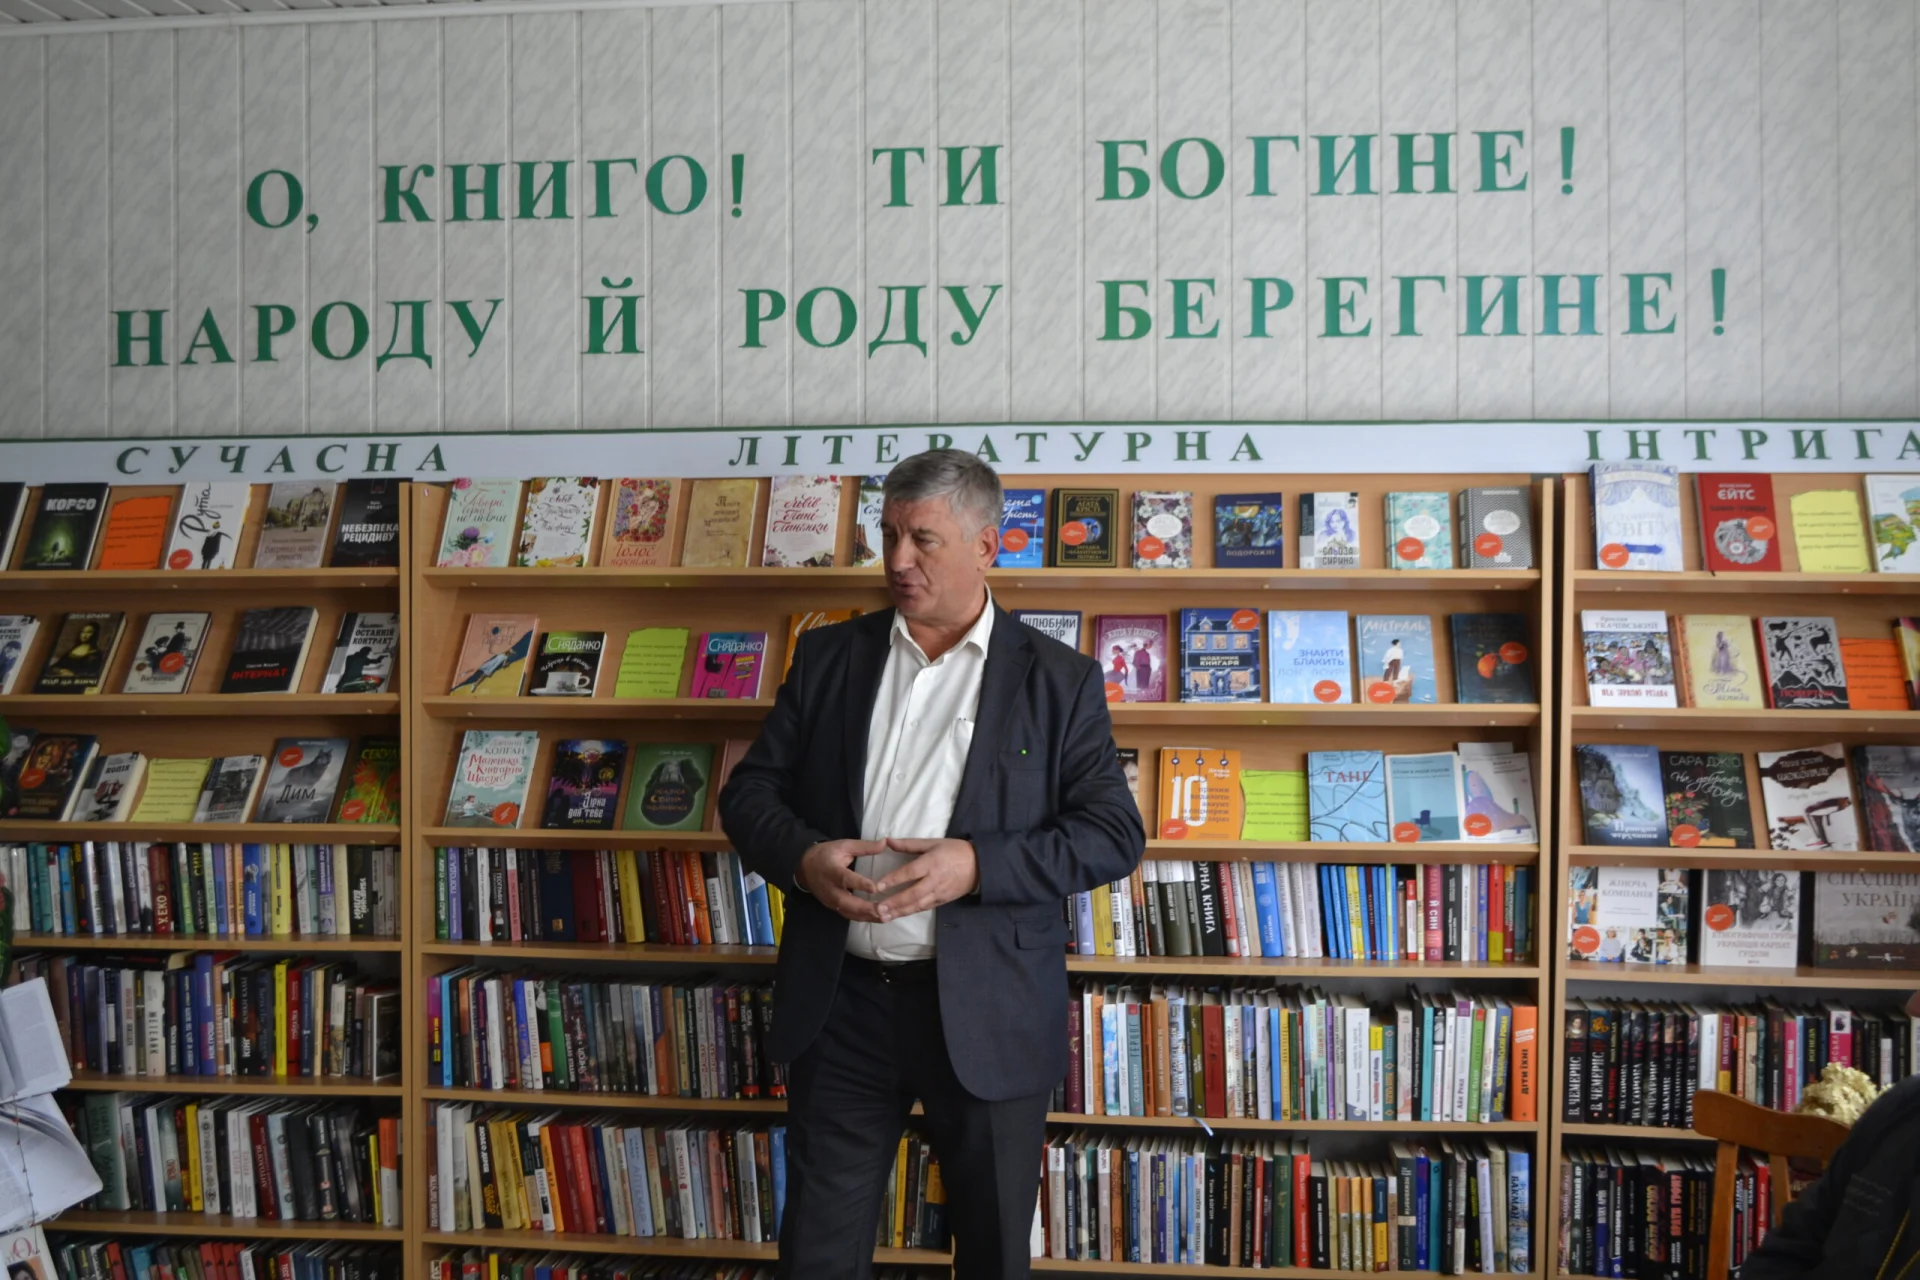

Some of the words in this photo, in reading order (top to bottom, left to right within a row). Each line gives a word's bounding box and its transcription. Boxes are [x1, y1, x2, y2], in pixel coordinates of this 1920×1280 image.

[248, 171, 319, 229] О,
[385, 155, 745, 223] КНИГО!
[874, 147, 999, 207] ТИ
[1104, 128, 1575, 200] БОГИНЕ!
[118, 301, 501, 369] НАРОДУ
[589, 278, 639, 355] Й
[745, 287, 1000, 356] РОДУ
[1104, 270, 1726, 341] БЕРЕГИНЕ!
[116, 443, 449, 475] СУЧАСНА
[729, 431, 1263, 466] ЛІТЕРАТУРНА
[1585, 428, 1920, 464] ІНТРИГА
[1717, 489, 1756, 500] ЄЙТС
[45, 498, 97, 511] КОРСО
[341, 524, 399, 533] НЕБЕЗПЕКА
[343, 533, 394, 542] РЕЦИДИВУ
[352, 637, 394, 646] КОНТРАКТ
[355, 628, 395, 637] ОСТАННІЙ
[549, 636, 601, 652] Сняданко
[708, 638, 763, 653] Сняданко
[1293, 658, 1345, 667] БЛАКИТЬ
[1300, 649, 1344, 658] ЗНАЙТИ
[232, 668, 288, 681] ІНТЕРНАТ
[1669, 755, 1703, 767] САРА
[1171, 774, 1208, 827] 10
[1608, 880, 1648, 888] ЖІНОЧА
[1601, 889, 1654, 899] КОМПАНІЯ
[157, 895, 168, 915] ЕКО
[1202, 894, 1216, 934] КНИГА
[1429, 909, 1439, 930] СИН
[1500, 1016, 1508, 1036] РОМАН
[1520, 1048, 1529, 1069] ЇХНІ
[1520, 1070, 1529, 1094] ДІТИ
[1569, 1056, 1581, 1105] ЧЕМЕРИС
[1590, 1051, 1604, 1101] ЧЕМЕРИС
[1574, 1166, 1582, 1177] ЯР
[1511, 1175, 1520, 1219] БАКМАН
[1574, 1178, 1582, 1219] ХОЛОДНИЙ
[1614, 1210, 1622, 1235] СУВОРОВ
